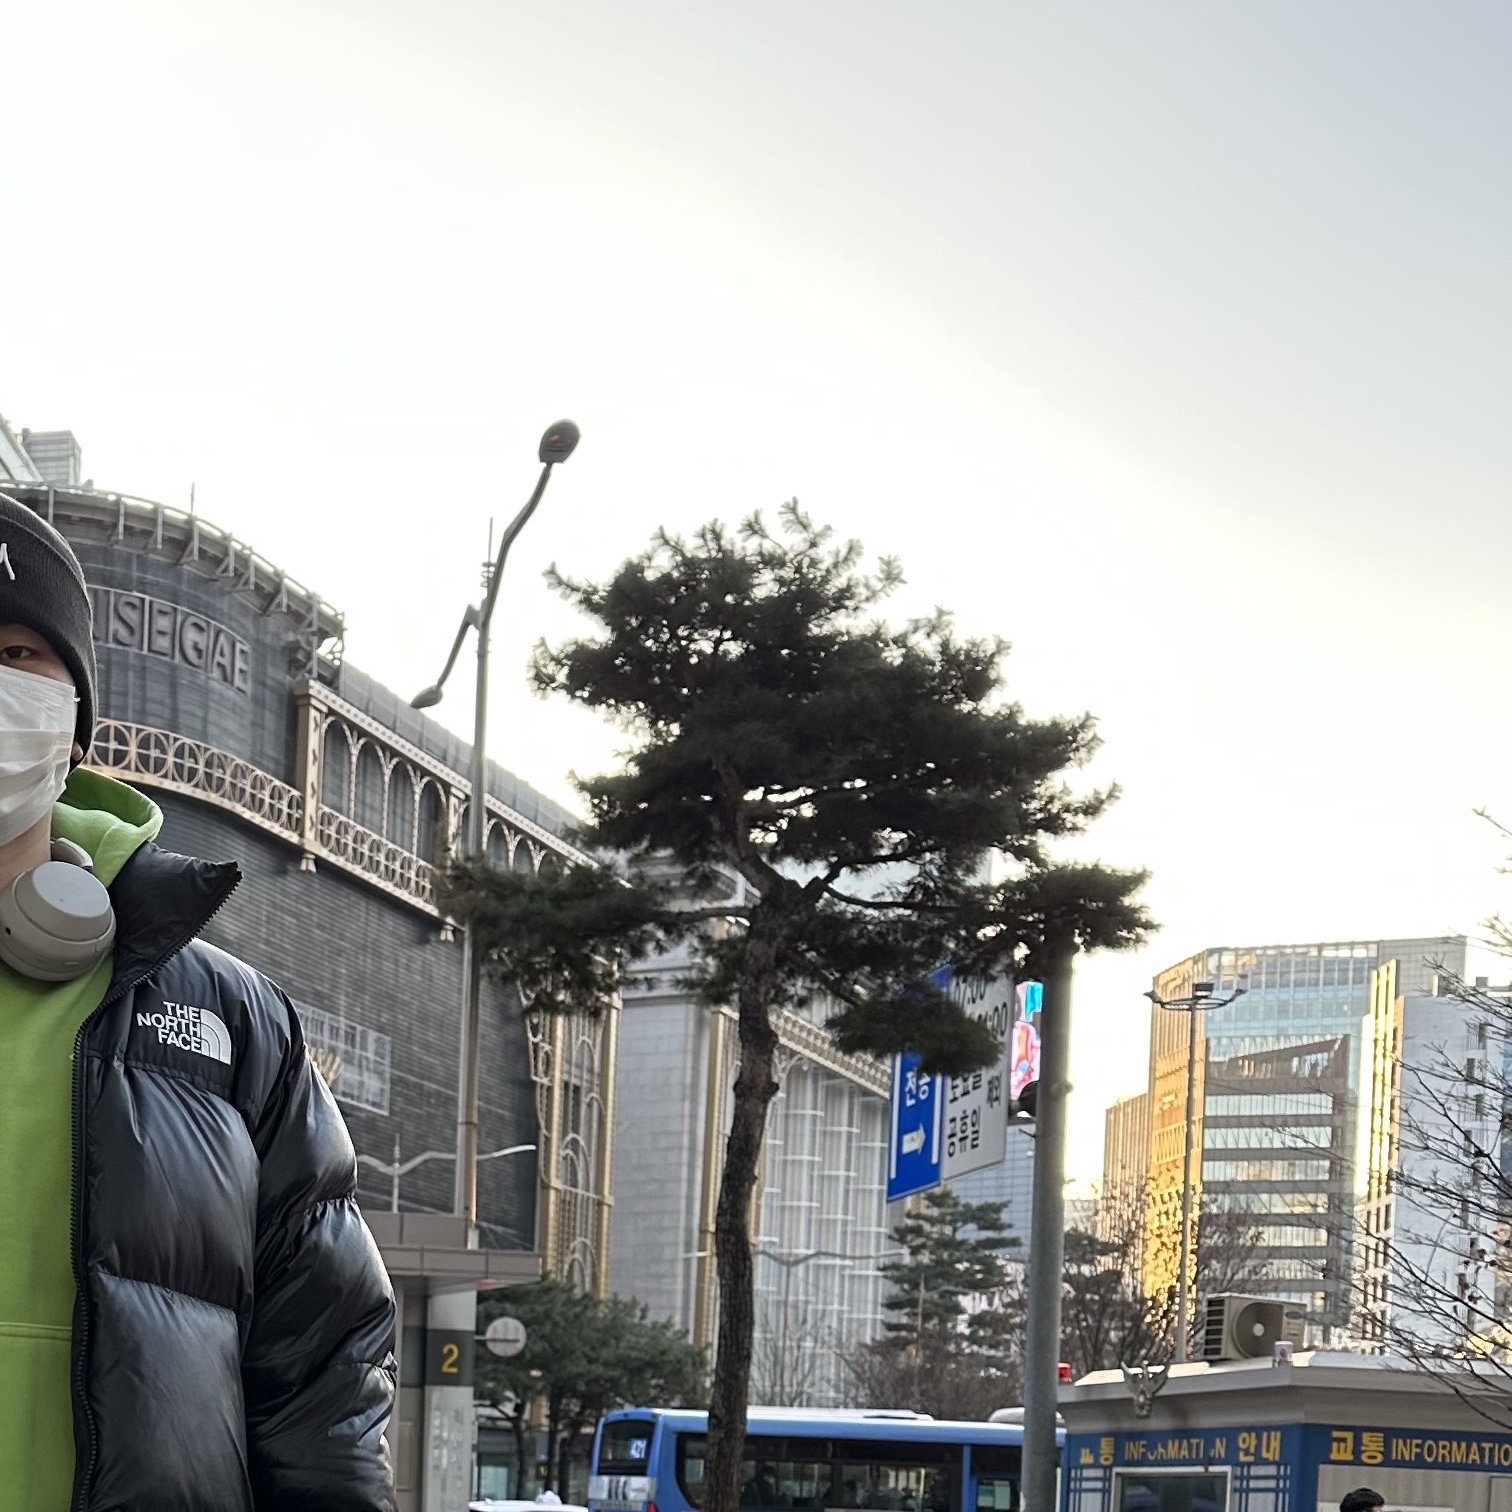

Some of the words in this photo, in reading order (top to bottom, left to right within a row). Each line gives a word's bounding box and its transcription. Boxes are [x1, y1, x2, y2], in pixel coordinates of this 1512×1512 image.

[136, 1012, 201, 1039] NORTH
[163, 1000, 201, 1023] THE
[157, 1027, 202, 1054] FACE
[947, 1105, 981, 1158] 공휴일
[441, 1343, 459, 1374] 2
[1124, 1437, 1226, 1462] INFRMATIN
[1238, 1430, 1281, 1463] 안내
[1330, 1430, 1385, 1465] 교통
